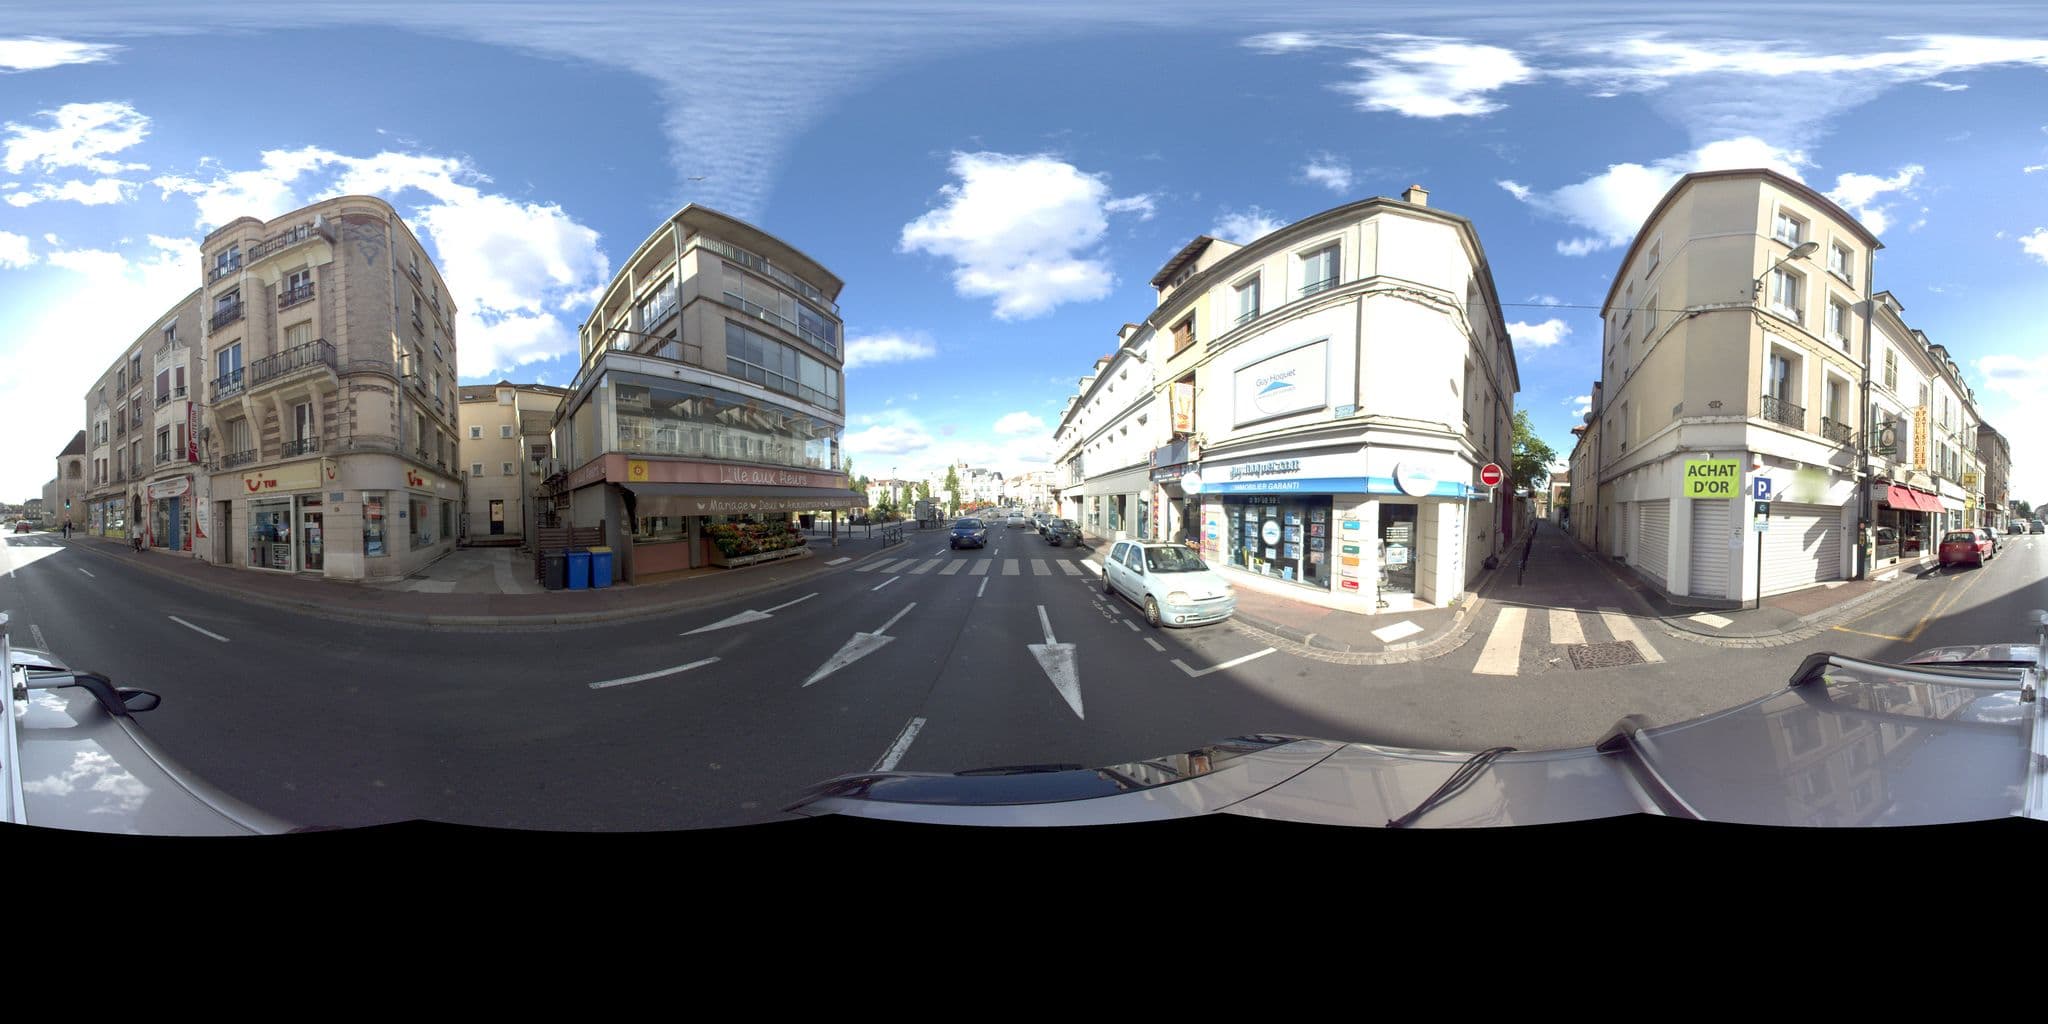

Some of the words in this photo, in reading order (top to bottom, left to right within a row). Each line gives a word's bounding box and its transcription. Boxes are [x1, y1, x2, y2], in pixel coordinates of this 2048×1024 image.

[1688, 464, 1737, 477] ACHAT
[751, 470, 777, 485] aux
[263, 480, 277, 489] TUI
[1268, 481, 1300, 490] GARANTI
[1693, 481, 1729, 493] D'OR
[1758, 481, 1767, 496] P
